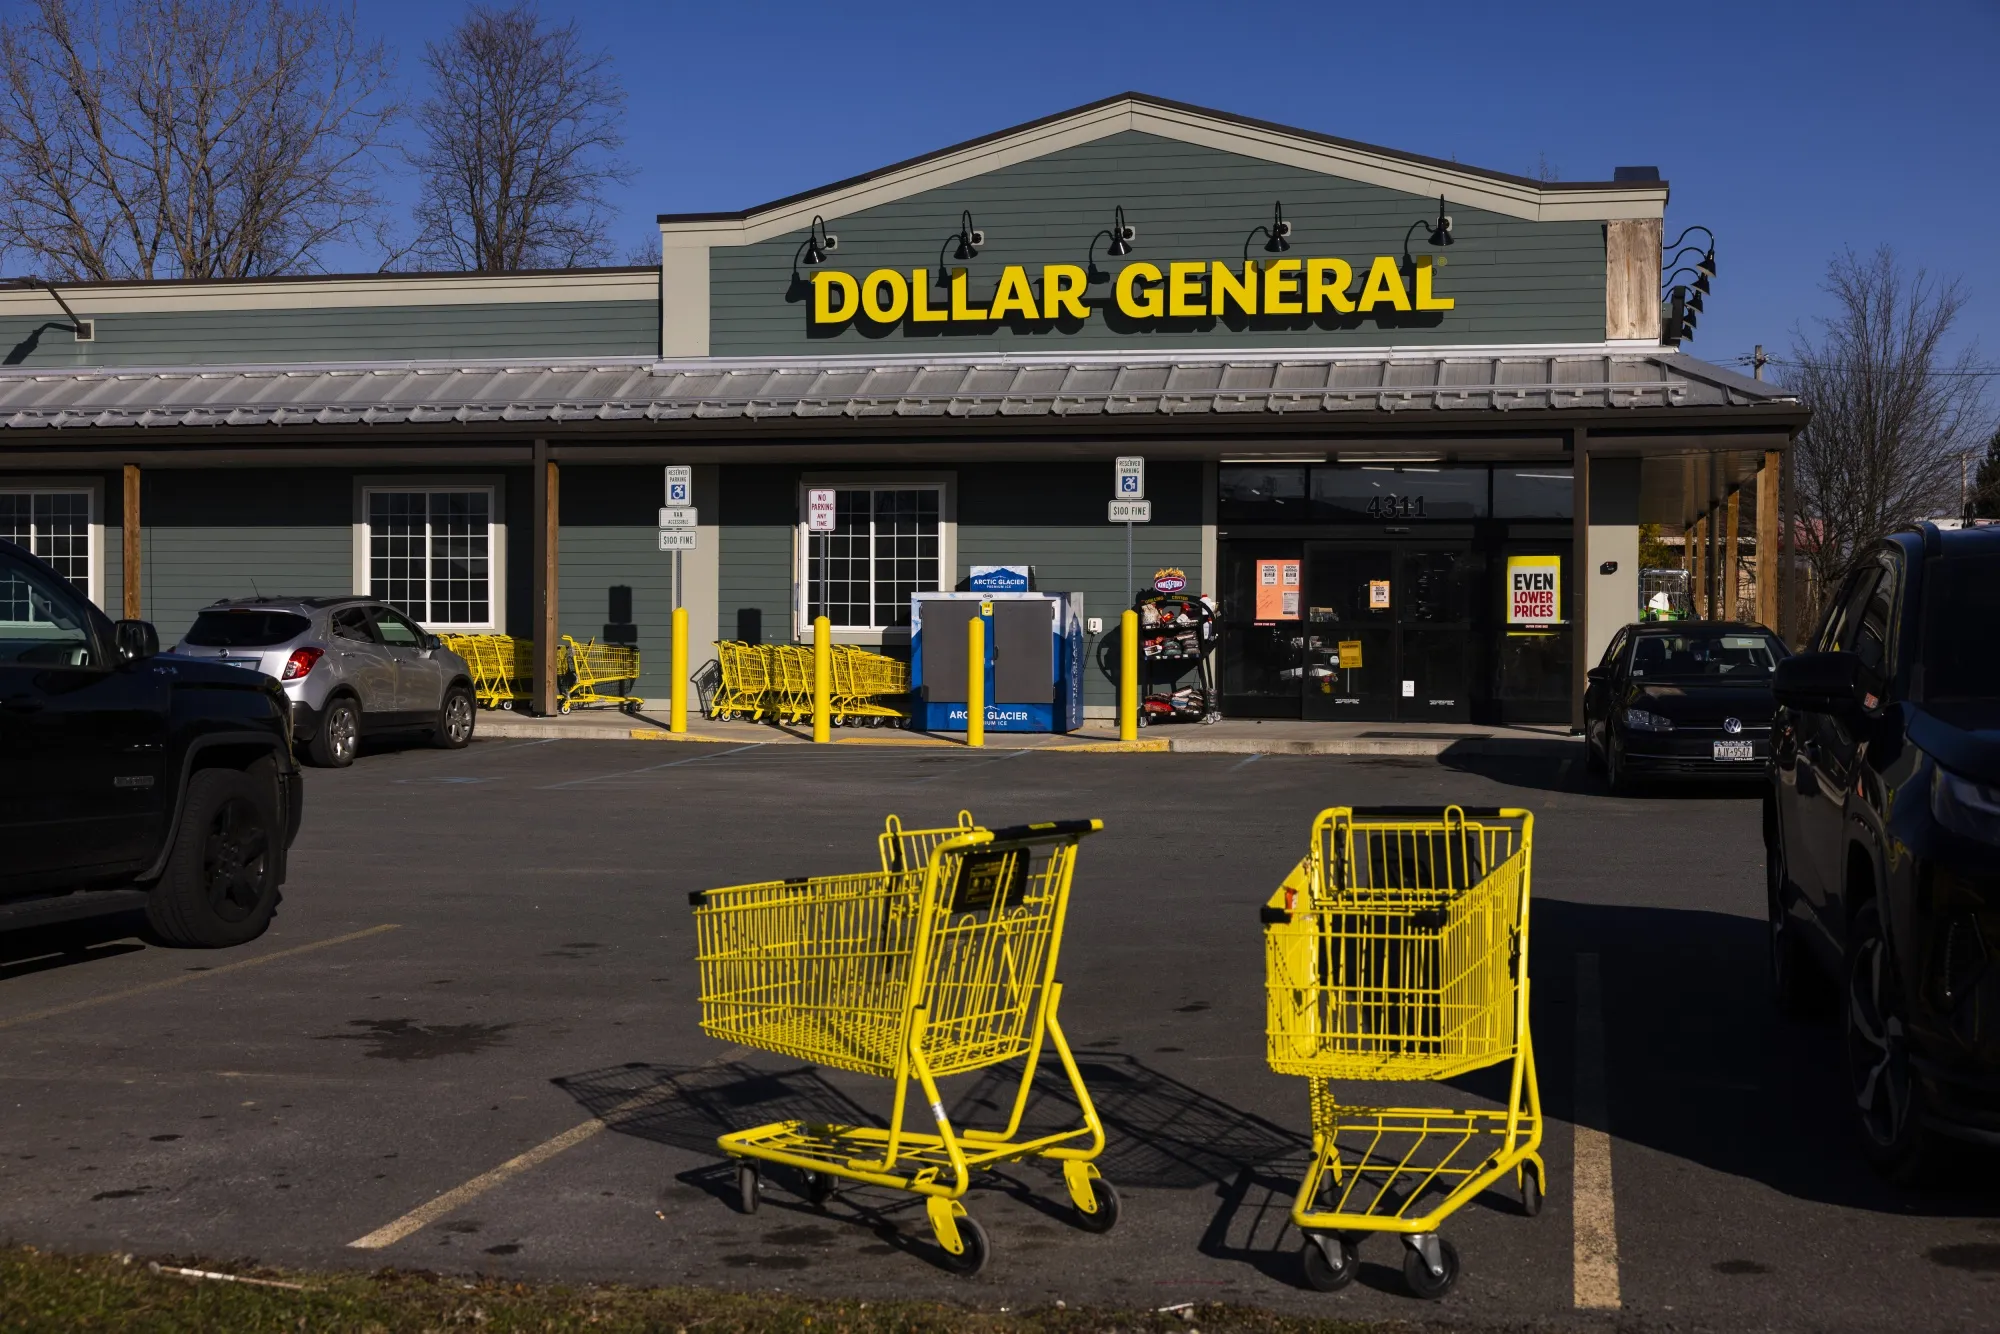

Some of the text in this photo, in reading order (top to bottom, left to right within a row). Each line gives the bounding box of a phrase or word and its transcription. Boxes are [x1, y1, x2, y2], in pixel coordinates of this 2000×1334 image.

[810, 255, 1455, 323] DOLLAR GENERAL
[817, 493, 827, 502] NO
[811, 503, 833, 511] PARKING
[1113, 506, 1147, 516] $100 FINE
[1366, 495, 1427, 518] 4311
[663, 535, 693, 545] $100 FINE
[1157, 579, 1183, 590] KINGSFORD
[1513, 573, 1554, 591] EVEN
[1513, 591, 1554, 604] LOWER
[1513, 604, 1554, 618] PRICES
[987, 711, 1028, 721] GLACIER
